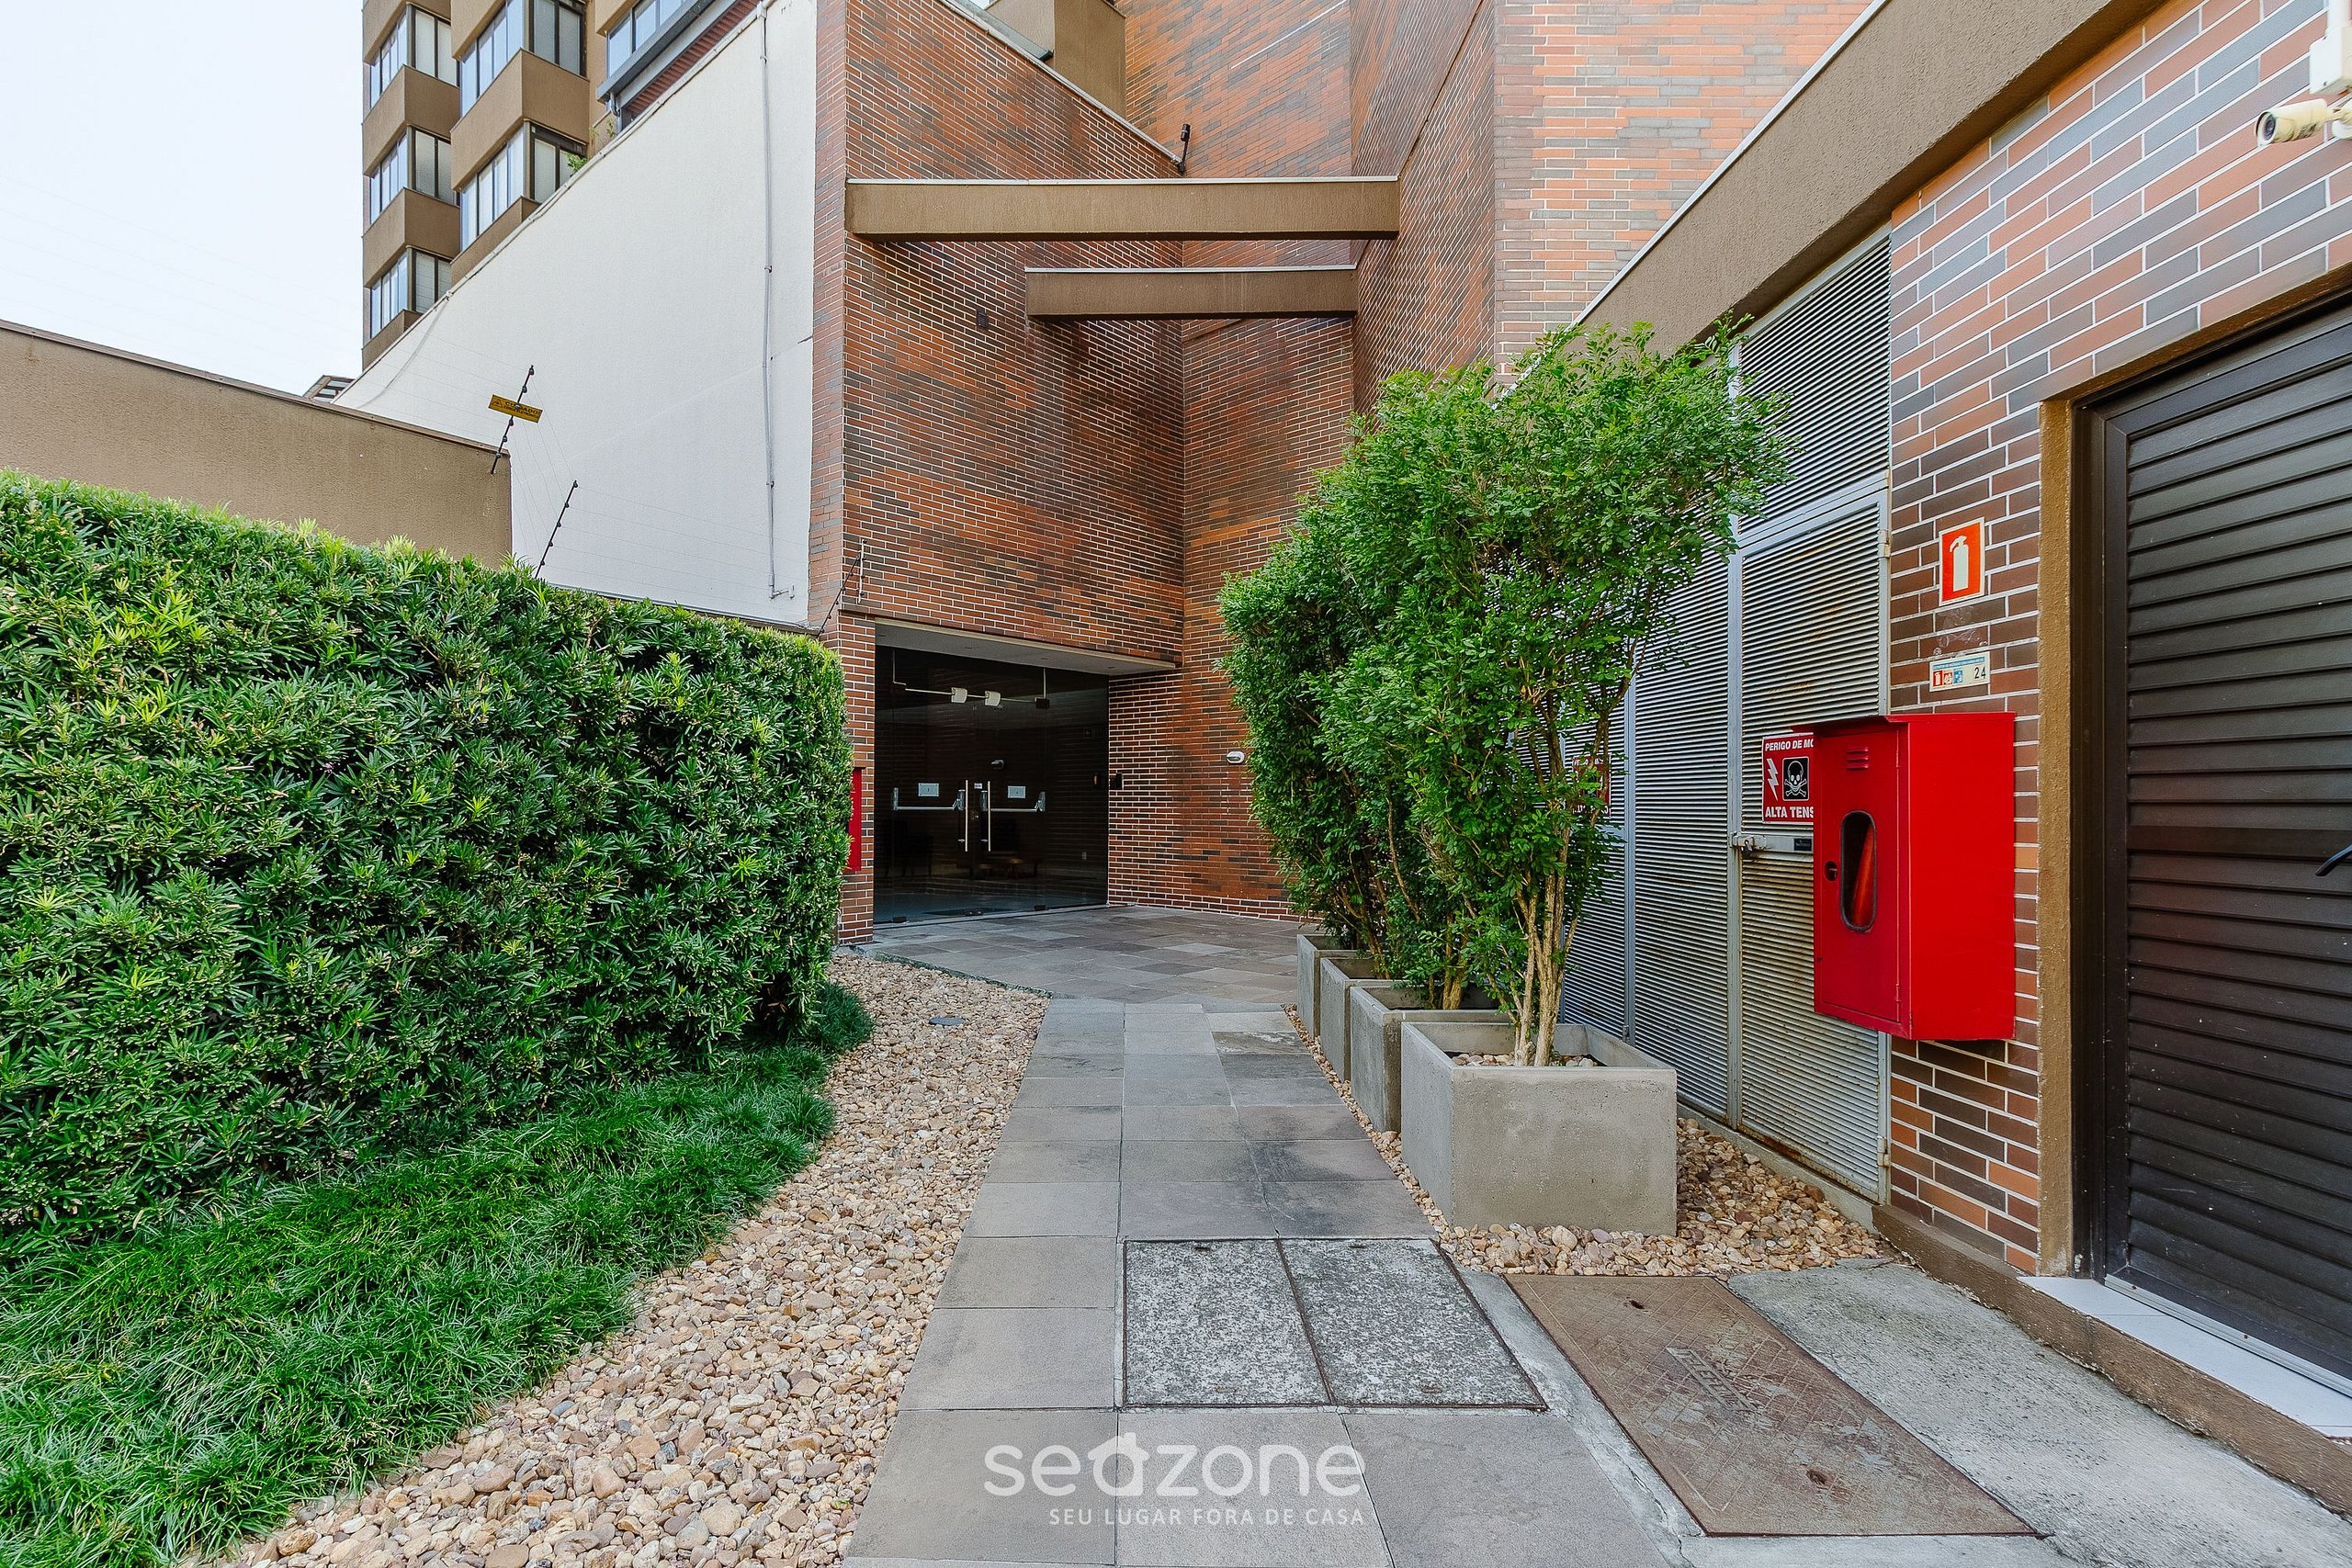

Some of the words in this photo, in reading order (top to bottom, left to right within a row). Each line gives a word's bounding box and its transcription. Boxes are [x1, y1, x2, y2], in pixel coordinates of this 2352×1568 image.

[1974, 666, 1986, 679] 24
[1765, 740, 1791, 751] PERIGO
[1792, 739, 1803, 749] DE
[1765, 806, 1788, 818] ALTA
